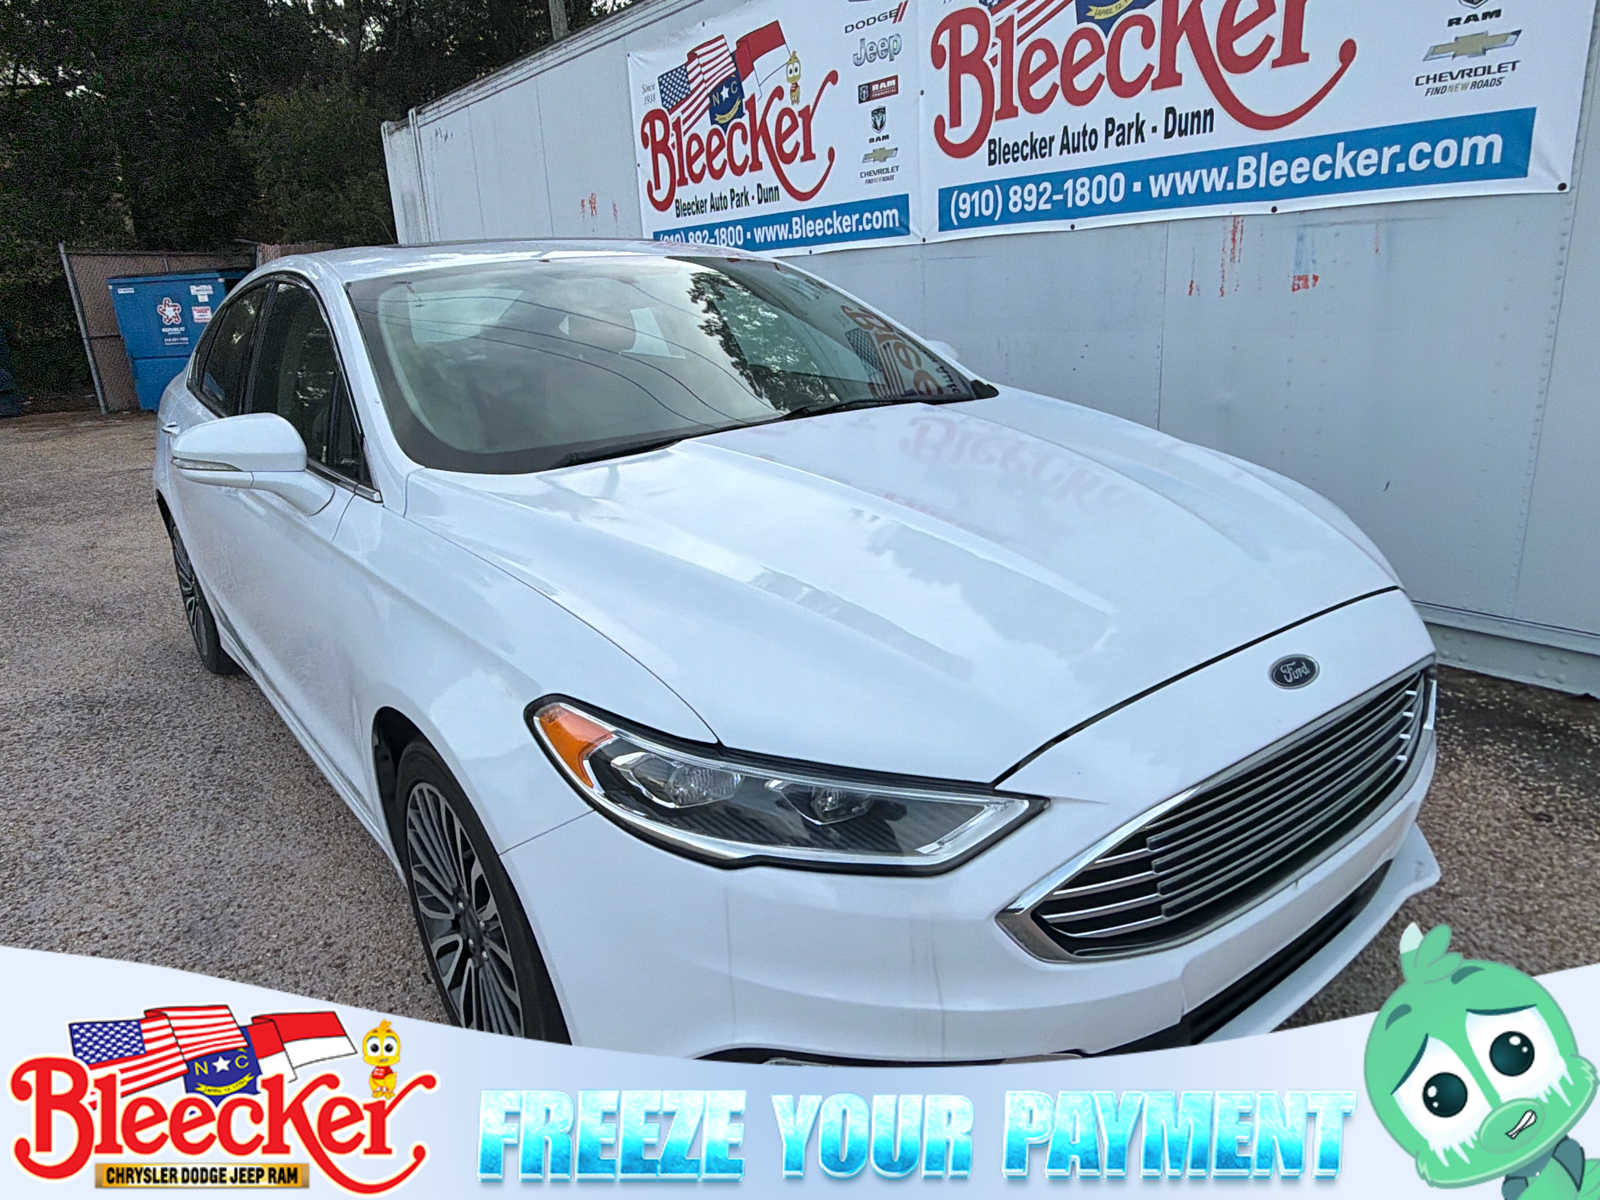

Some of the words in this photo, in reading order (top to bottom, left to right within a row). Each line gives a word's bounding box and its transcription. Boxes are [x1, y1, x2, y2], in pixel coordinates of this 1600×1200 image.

[845, 8, 898, 33] DODGE
[1447, 9, 1502, 27] RAM
[852, 33, 902, 67] Jeep
[871, 79, 896, 91] RAM
[1414, 60, 1520, 86] CHEVROLET
[1424, 84, 1448, 97] FIND
[1470, 76, 1505, 90] ROADS
[640, 70, 838, 212] Bleecker
[868, 134, 890, 144] RAM
[987, 131, 1055, 166] Bleecker
[1059, 122, 1099, 156] Auto
[1104, 112, 1146, 149] Park
[1164, 105, 1214, 140] Dunn
[859, 165, 900, 179] CHEVROLET
[950, 184, 1003, 226] (910)
[1008, 171, 1125, 214] 892-1800
[1149, 128, 1503, 199] www.Bleecker.com
[675, 194, 707, 218] Bleecker
[709, 191, 728, 213] Auto
[730, 185, 750, 209] Park
[756, 183, 780, 205] Dunn
[753, 207, 899, 243] www.Bleecker.com
[1280, 661, 1310, 683] Ford
